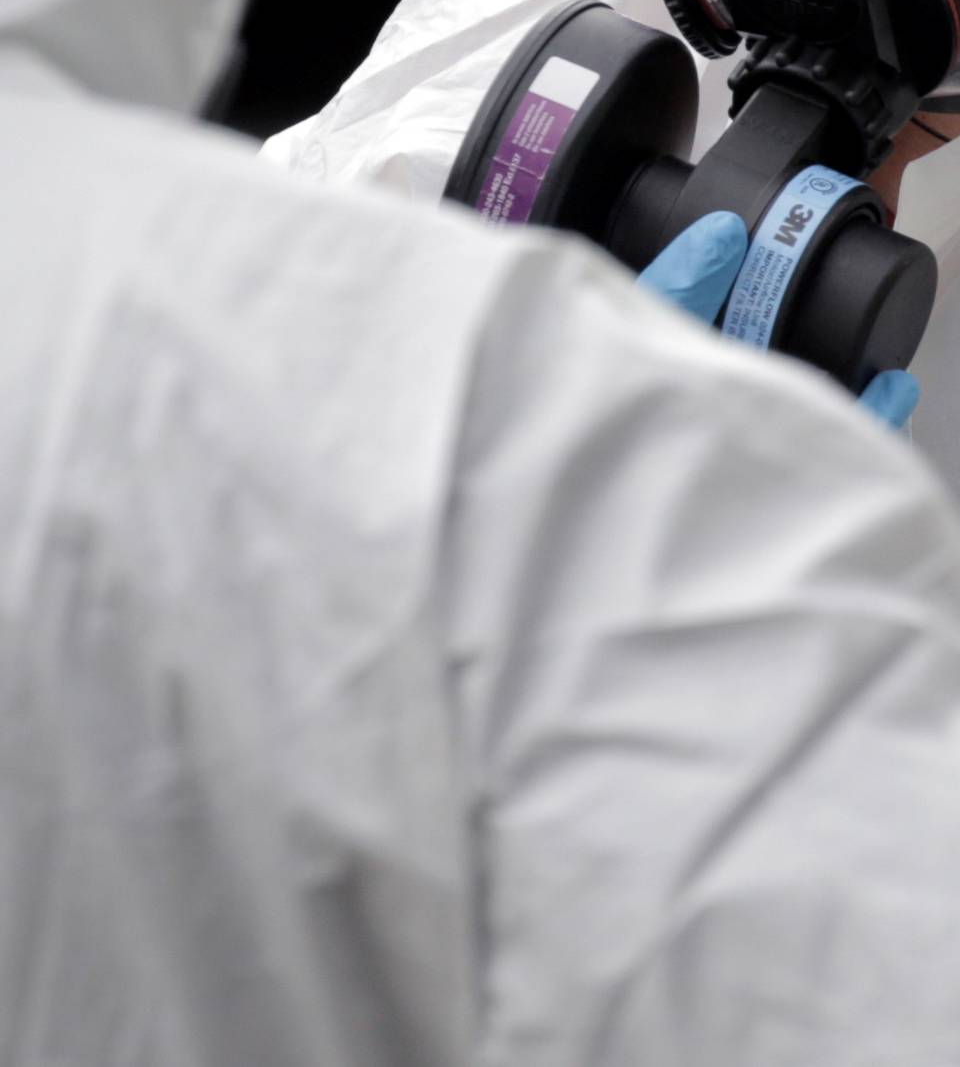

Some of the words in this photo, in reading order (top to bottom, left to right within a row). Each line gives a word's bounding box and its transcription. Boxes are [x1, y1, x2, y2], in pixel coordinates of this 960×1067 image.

[774, 204, 814, 248] 3M
[741, 245, 766, 293] CORRECT
[762, 257, 794, 321] POWERFLOW
